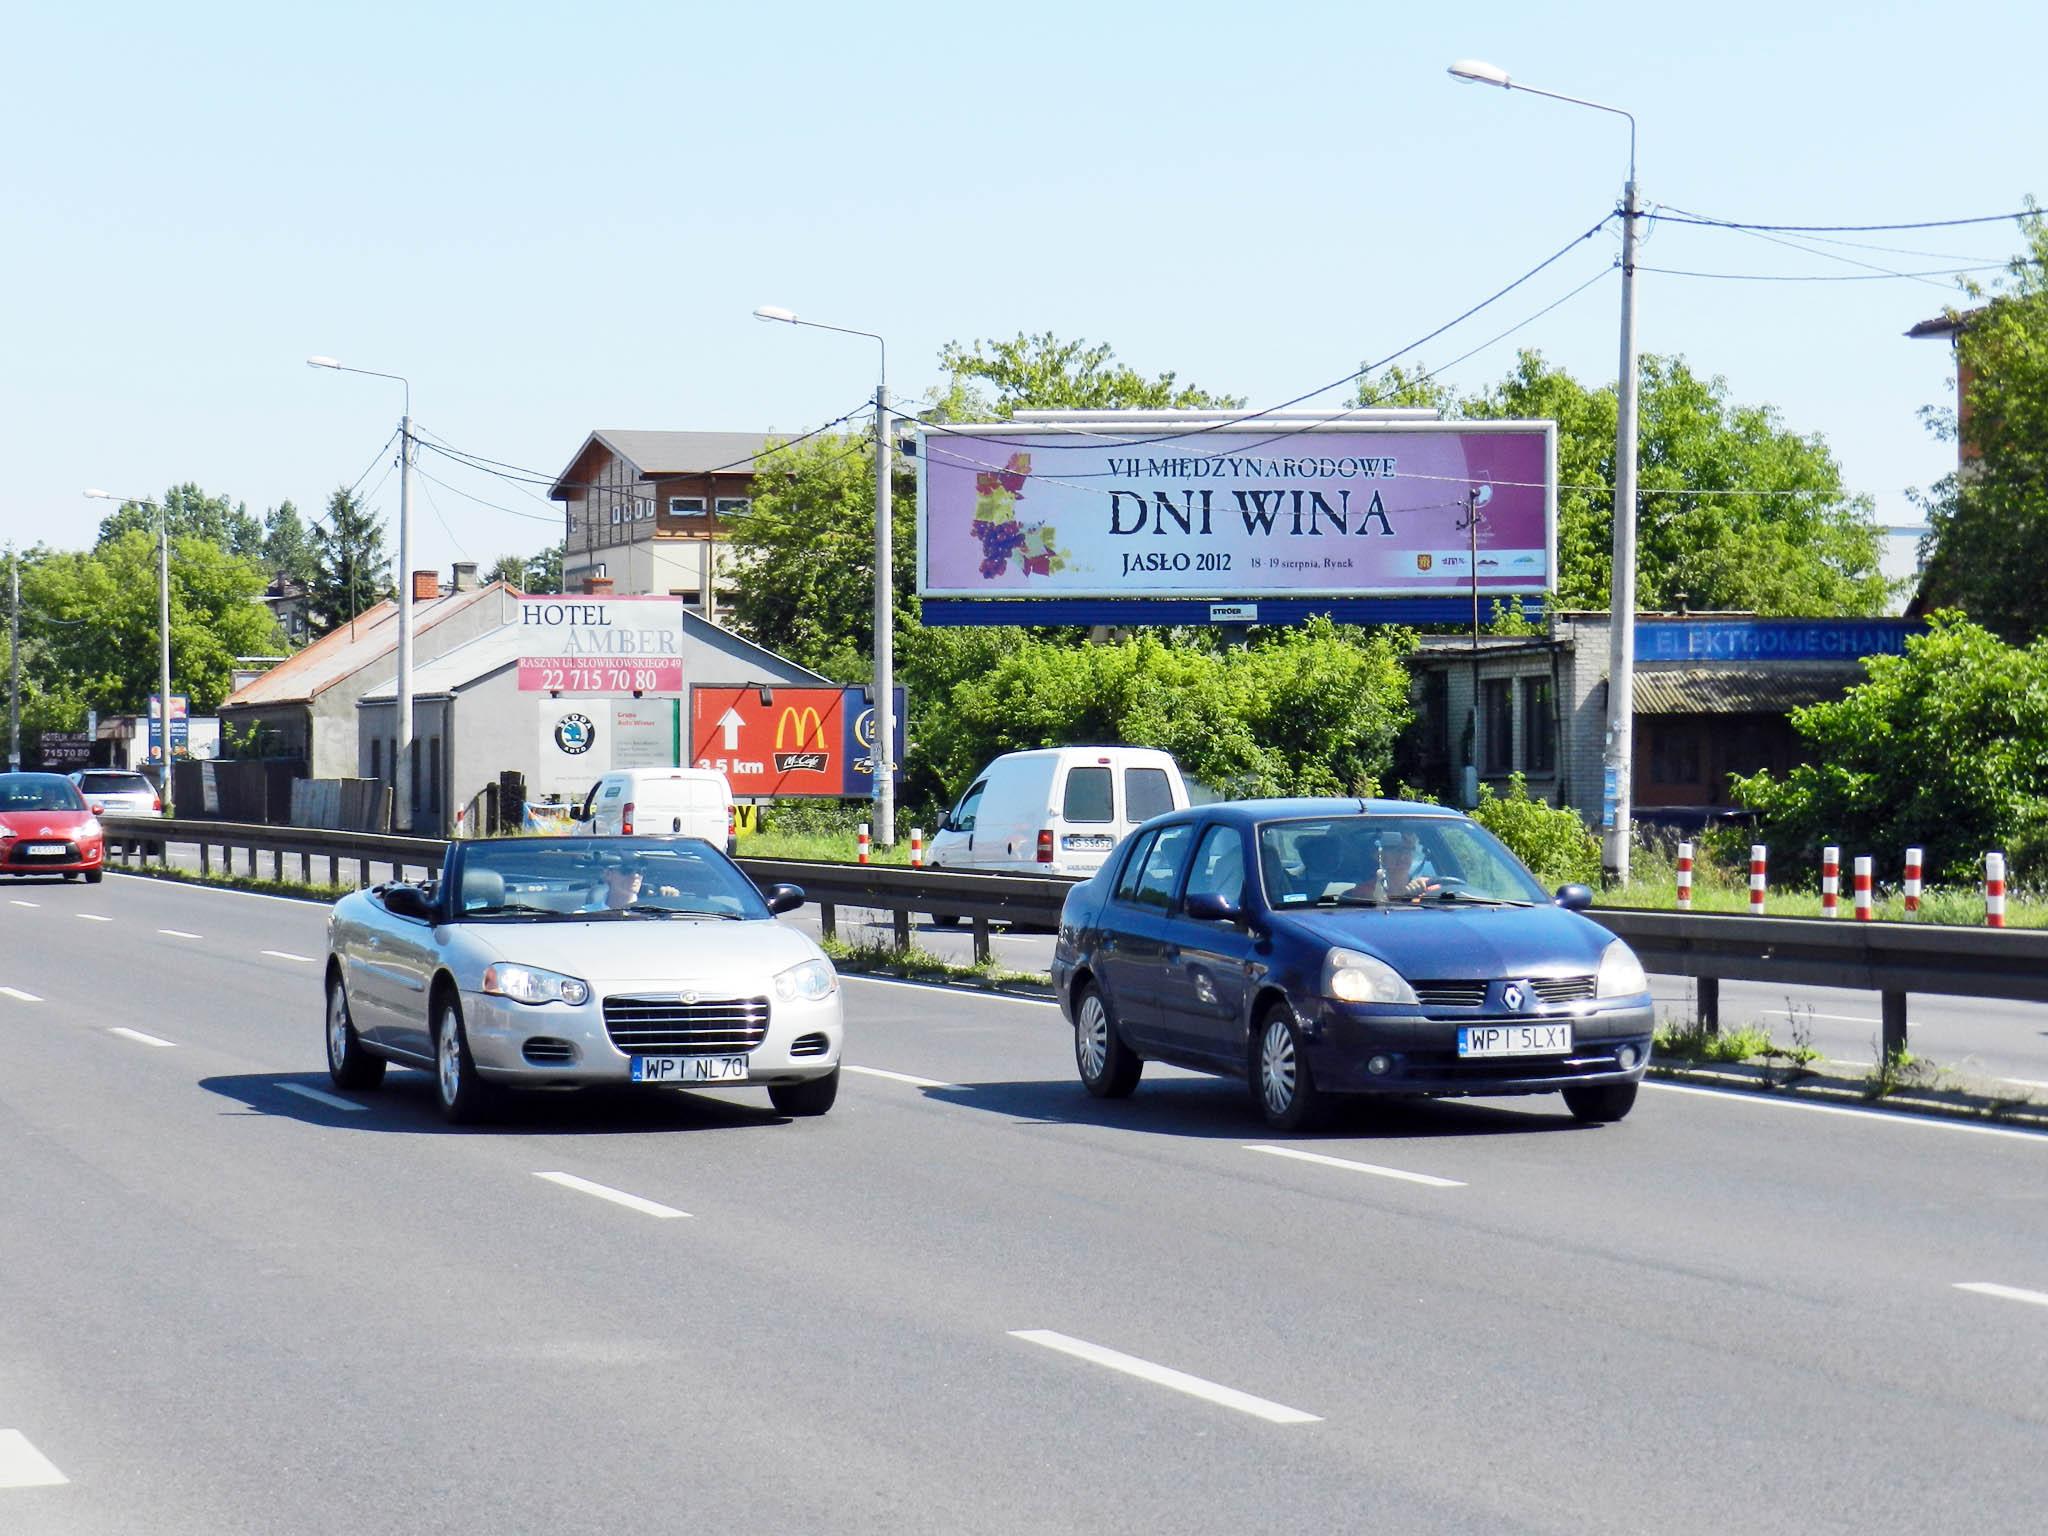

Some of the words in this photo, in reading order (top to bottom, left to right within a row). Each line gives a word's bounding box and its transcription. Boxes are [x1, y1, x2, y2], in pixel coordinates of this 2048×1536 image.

[1107, 458, 1140, 478] VII
[1148, 457, 1396, 480] MIĘDZYNARODOWE
[1107, 489, 1215, 536] DNI
[1231, 489, 1396, 537] WINA
[1122, 552, 1191, 577] JASŁO
[1195, 552, 1232, 572] 2012
[1250, 557, 1261, 568] 18
[1269, 557, 1280, 568] 19
[1323, 557, 1354, 570] Rynek
[522, 604, 612, 626] HOTEL
[562, 628, 678, 654] AMBER
[1655, 629, 1904, 653] ELEKTROMECHANI
[519, 657, 561, 669] RASZYN
[670, 657, 682, 669] 49
[542, 669, 565, 690] 22
[569, 669, 602, 690] 715
[608, 669, 630, 690] 70
[635, 669, 657, 690] 80
[732, 758, 764, 775] km
[1521, 1027, 1567, 1049] 5LX1
